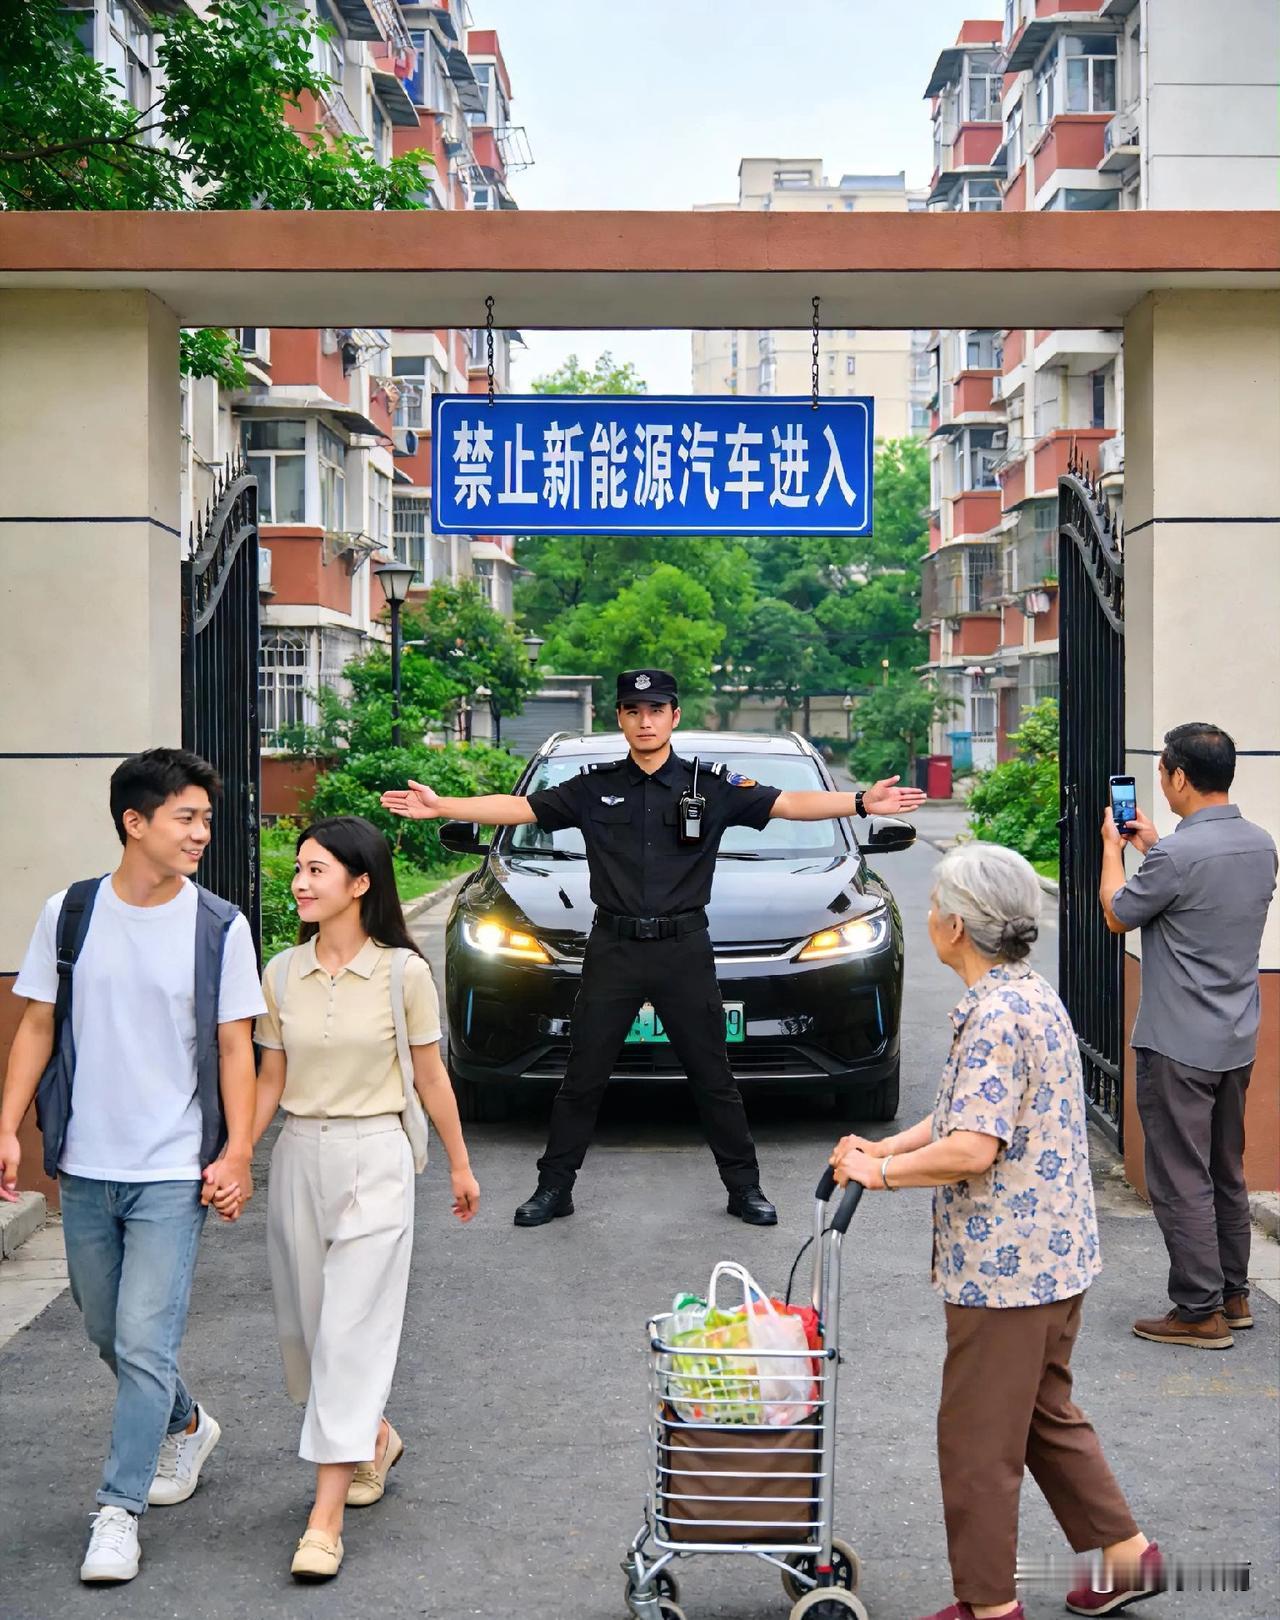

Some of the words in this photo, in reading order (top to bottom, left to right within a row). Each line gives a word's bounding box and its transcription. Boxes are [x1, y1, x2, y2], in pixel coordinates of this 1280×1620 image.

[453, 420, 857, 511] 禁止新能源汽车进入
